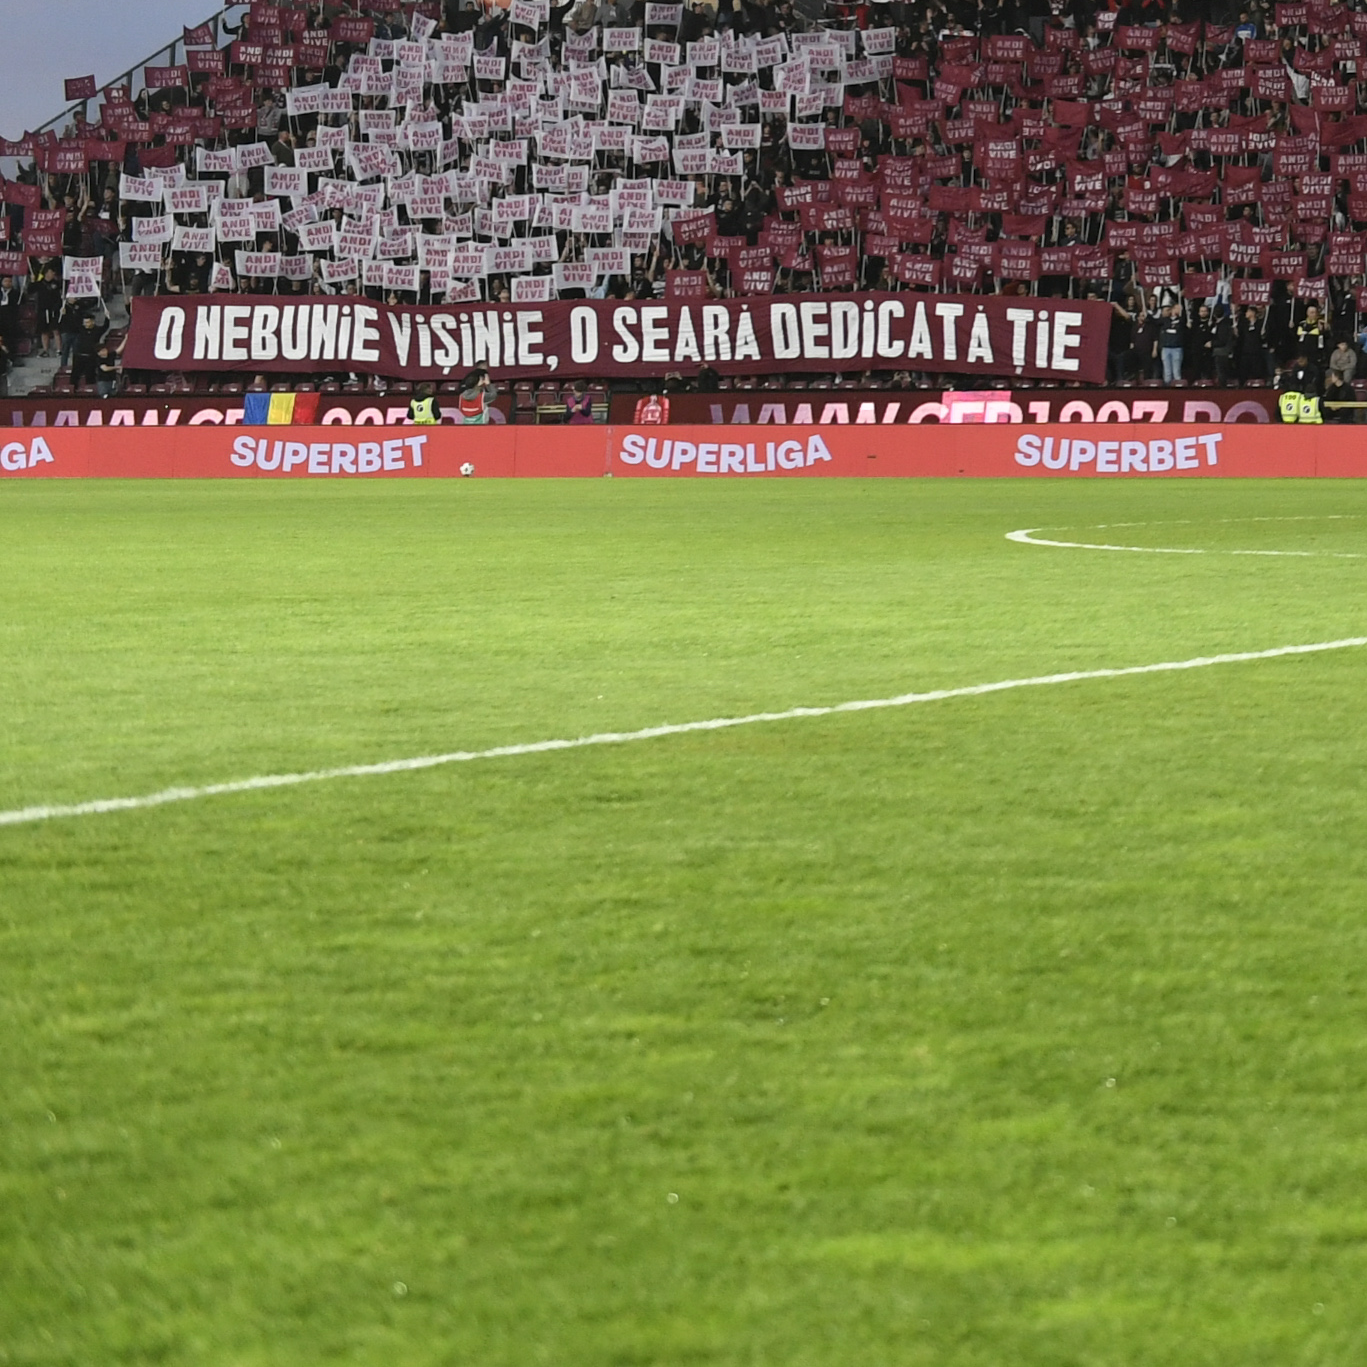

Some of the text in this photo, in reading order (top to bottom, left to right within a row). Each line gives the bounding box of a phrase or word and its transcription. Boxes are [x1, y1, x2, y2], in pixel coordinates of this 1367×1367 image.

[650, 44, 677, 53] ANDI
[649, 52, 677, 63] VIVE
[1302, 175, 1332, 185] ANDI
[658, 182, 687, 191] ANDI
[784, 186, 812, 196] ANDI
[1303, 185, 1331, 194] VIVE
[658, 190, 687, 200] VIVE
[784, 195, 812, 205] VIVE
[411, 197, 441, 206] ANDI
[411, 206, 441, 215] VIVE
[340, 236, 372, 247] ANDI
[129, 244, 161, 253] ANDI
[339, 247, 370, 257] VIVE
[739, 248, 770, 258] ANDI
[1230, 244, 1260, 253] ANDI
[129, 252, 161, 263] VIVE
[246, 256, 277, 265] ANDI
[453, 256, 482, 265] ANDI
[495, 251, 526, 261] ANDI
[1229, 253, 1259, 264] VIVE
[495, 260, 526, 269] VIVE
[739, 258, 770, 267] VIVE
[245, 264, 277, 274] VIVE
[386, 267, 415, 277] ANDI
[452, 264, 482, 275] VIVE
[1145, 265, 1171, 274] ANDI
[386, 277, 414, 286] VIVE
[743, 272, 771, 282] ANDI
[1145, 274, 1172, 284] VIVE
[515, 281, 545, 290] ANDI
[743, 282, 770, 291] VIVE
[1240, 282, 1270, 291] ANDI
[515, 289, 545, 299] VIVE
[1240, 292, 1268, 302] VIVE
[154, 306, 186, 361] O
[570, 306, 598, 365] O
[230, 435, 427, 474] SUPERBET
[620, 434, 832, 474] SUPERLIGA
[1014, 433, 1222, 473] SUPERBET
